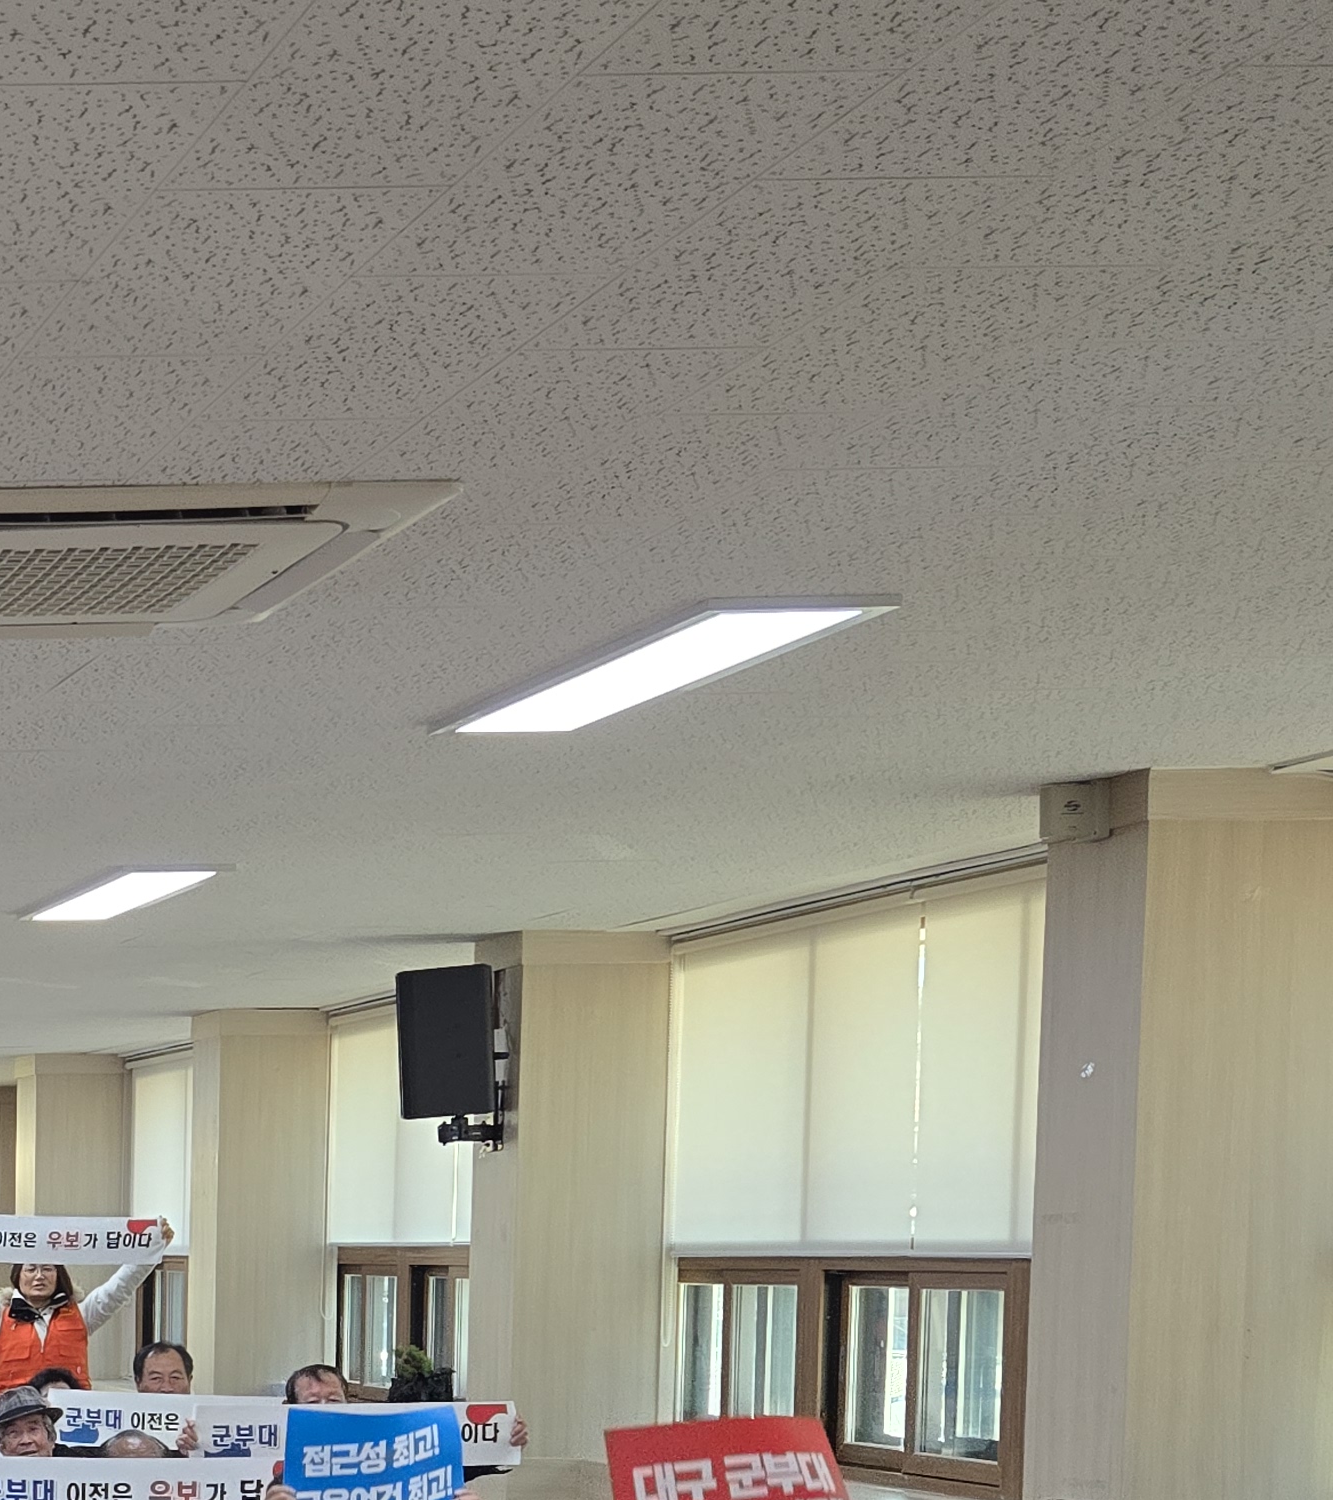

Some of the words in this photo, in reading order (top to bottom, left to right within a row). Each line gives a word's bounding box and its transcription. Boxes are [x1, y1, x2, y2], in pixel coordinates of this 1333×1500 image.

[106, 1231, 152, 1249] 답이다
[65, 1408, 122, 1429] 군부대
[131, 1411, 180, 1432] 이전은
[212, 1425, 278, 1448] 군부대
[461, 1422, 499, 1443] 이다
[303, 1441, 386, 1478] 접근성
[393, 1424, 440, 1468] 최고!
[723, 1452, 836, 1500] 군부대
